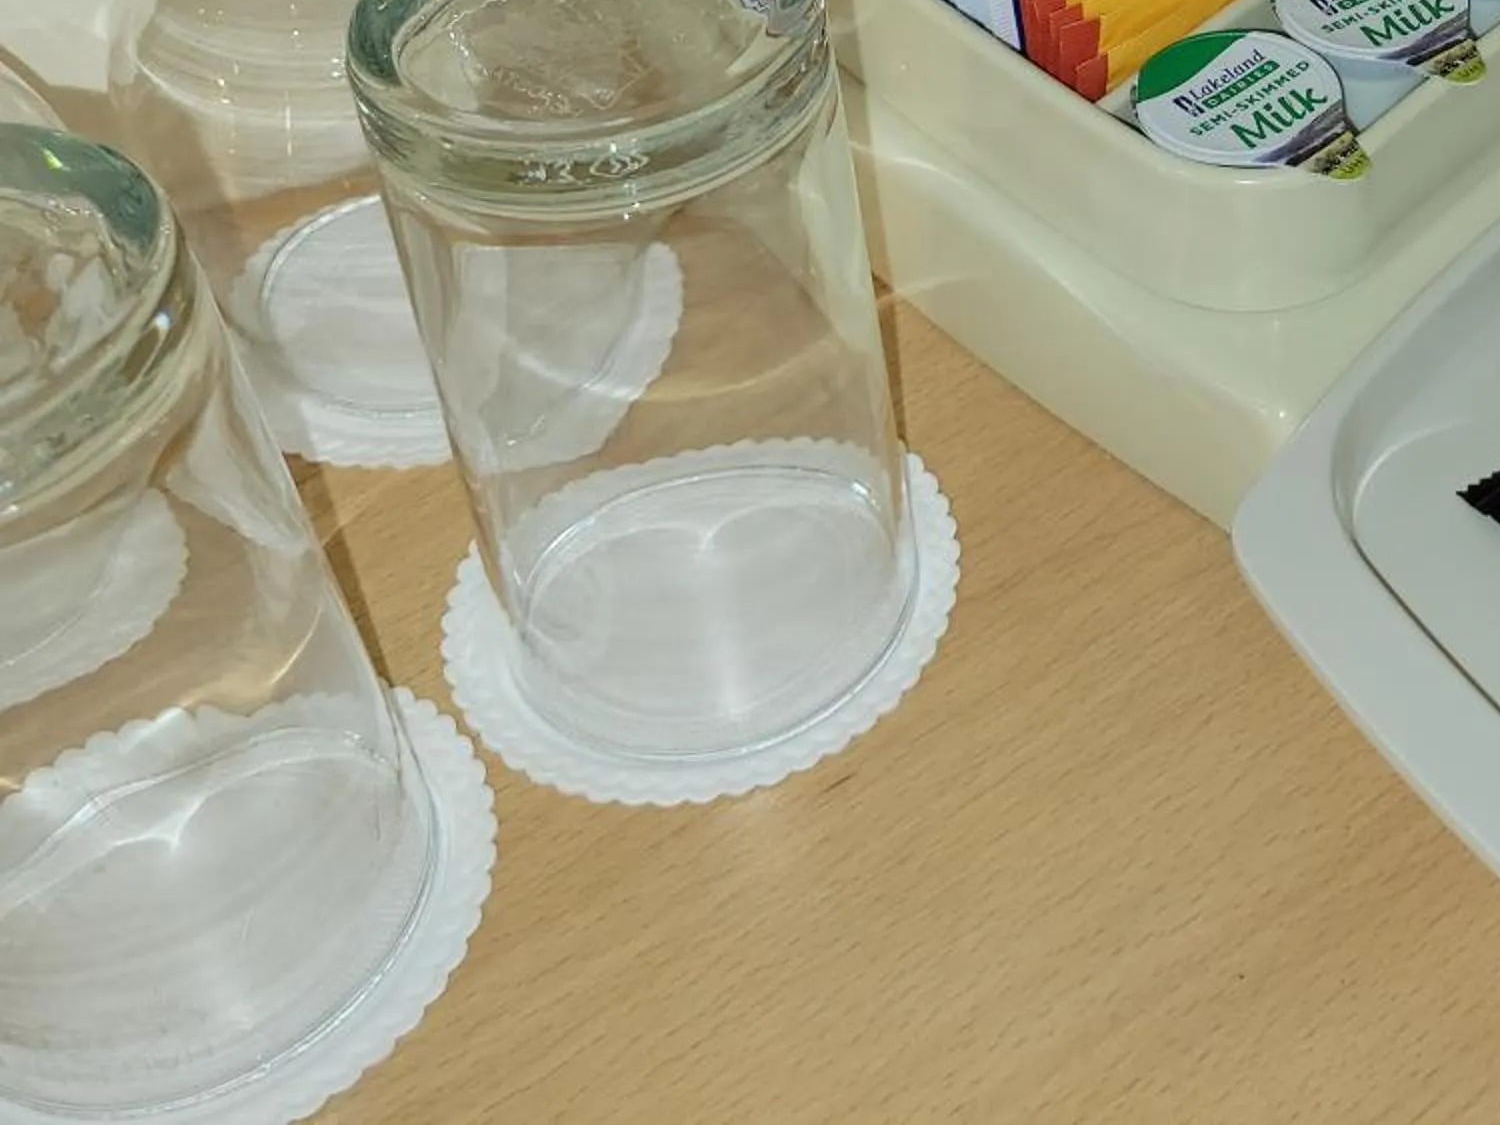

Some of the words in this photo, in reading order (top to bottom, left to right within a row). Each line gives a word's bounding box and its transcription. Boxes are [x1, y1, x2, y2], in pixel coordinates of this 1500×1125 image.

[1190, 49, 1266, 101] Lakeland
[1190, 61, 1310, 136] SEMI-SKIMMED
[1230, 88, 1328, 148] Milk
